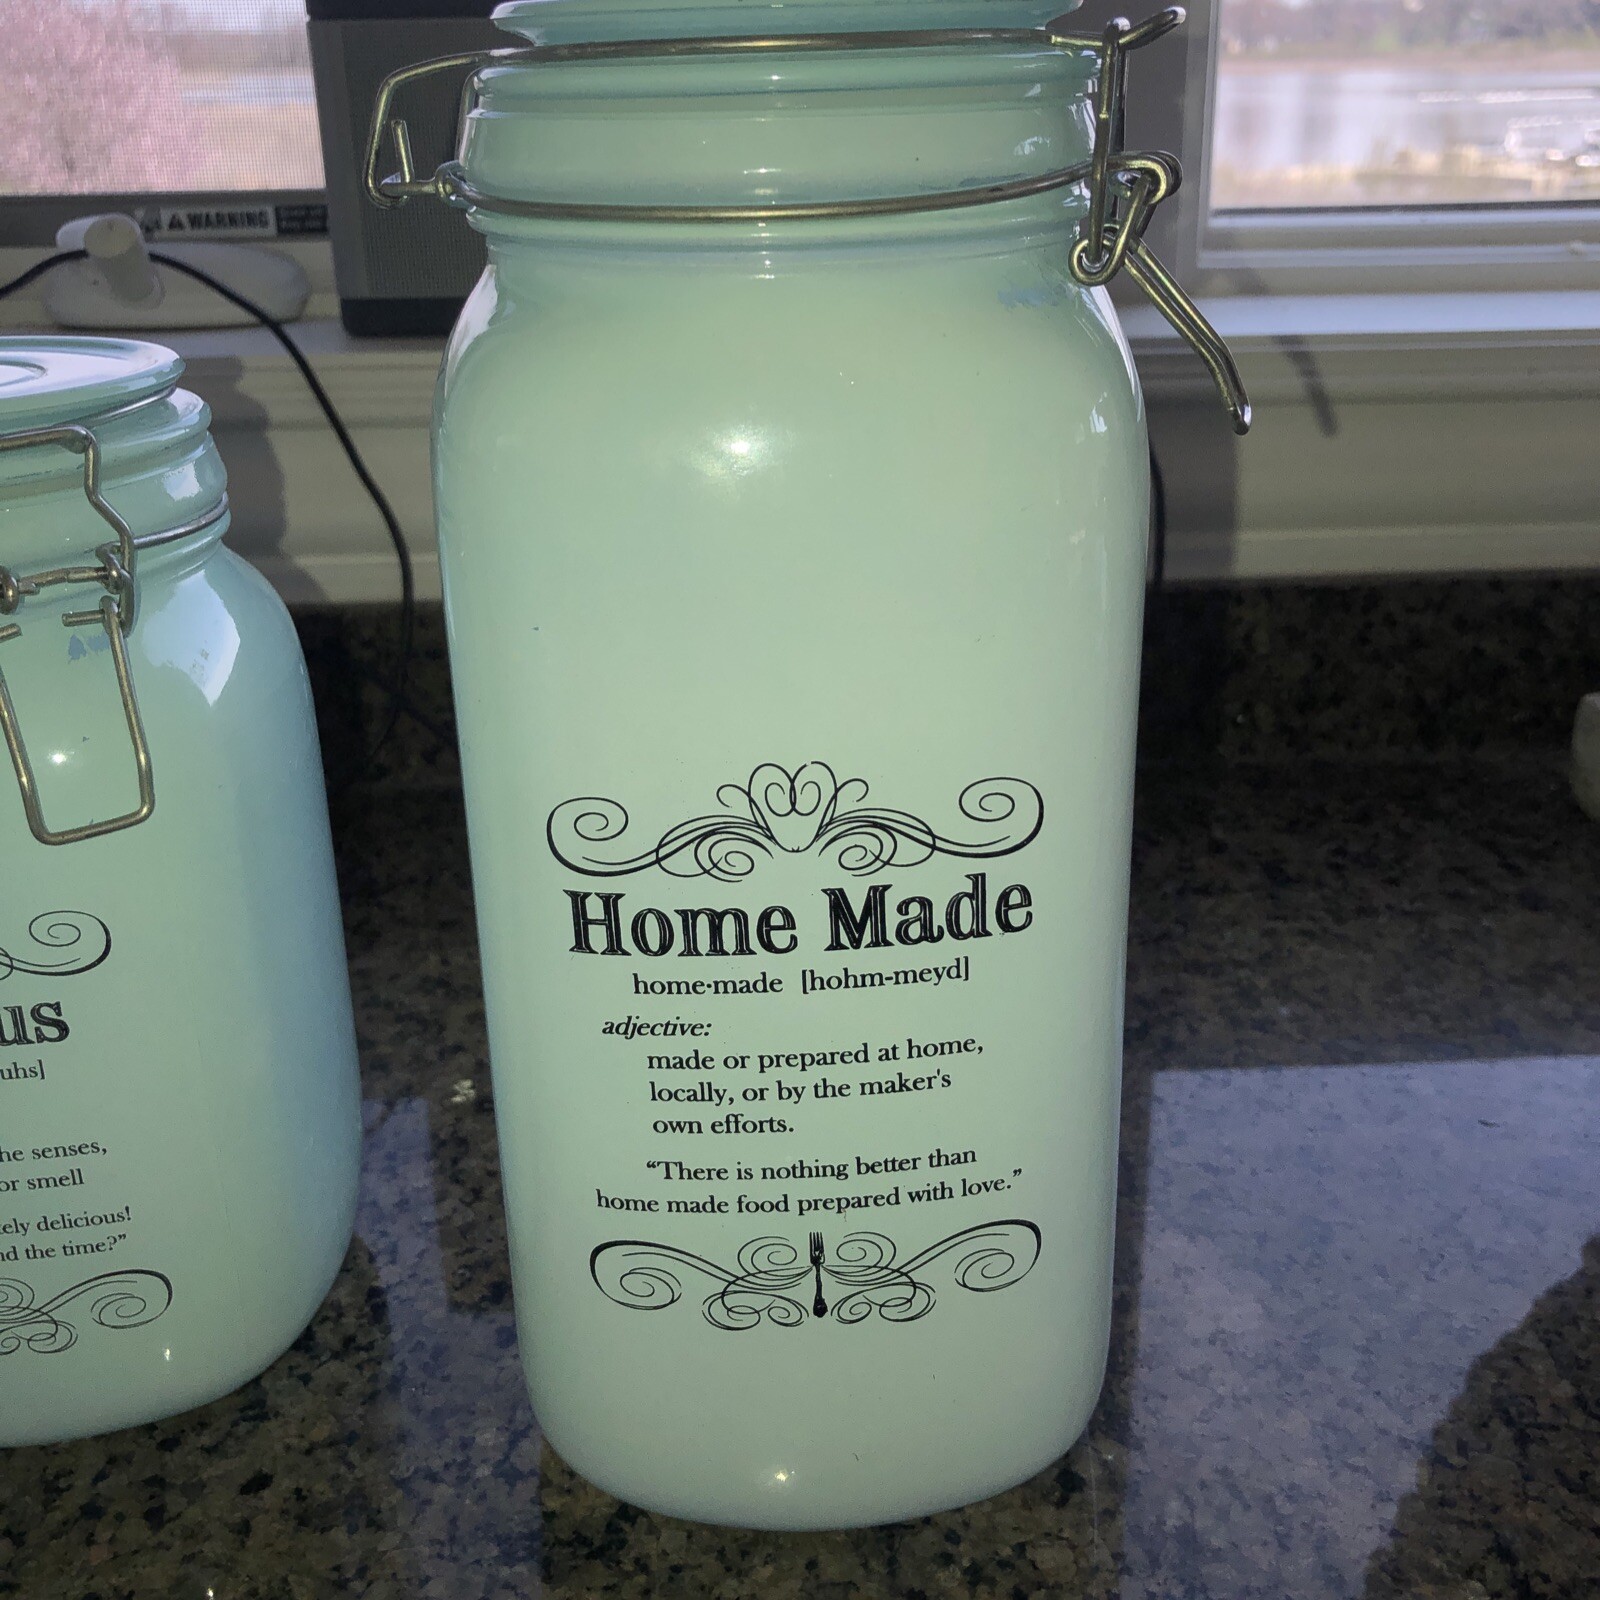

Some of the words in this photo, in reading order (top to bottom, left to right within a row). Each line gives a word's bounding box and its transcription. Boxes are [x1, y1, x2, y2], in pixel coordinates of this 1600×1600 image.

[186, 211, 270, 229] WARNING
[563, 889, 798, 957] Home
[821, 872, 1033, 951] Made
[802, 956, 969, 994] [hohm-meyd]
[602, 1015, 712, 1040] adjective:
[647, 1049, 715, 1070] made
[723, 1055, 750, 1069] or
[757, 1042, 870, 1073] prepared
[878, 1044, 900, 1062] at
[907, 1038, 983, 1059] home,
[649, 1081, 734, 1106] locally,
[742, 1088, 769, 1101] or
[775, 1080, 806, 1104] by
[813, 1078, 851, 1098] the
[859, 1068, 951, 1095] maker's
[653, 1120, 703, 1134] own
[711, 1113, 794, 1134] efforts.
[32, 1141, 107, 1159] senses,
[737, 1161, 753, 1180] is
[761, 1159, 849, 1180] nothing
[855, 1156, 921, 1175] better
[928, 1148, 977, 1168] than
[27, 1168, 84, 1190] smell
[596, 1189, 659, 1212] home
[666, 1195, 729, 1213] made
[737, 1194, 790, 1213] food
[797, 1187, 901, 1216] prepared
[907, 1181, 954, 1203] with
[37, 1206, 131, 1232] delicious!
[24, 1244, 56, 1260] the
